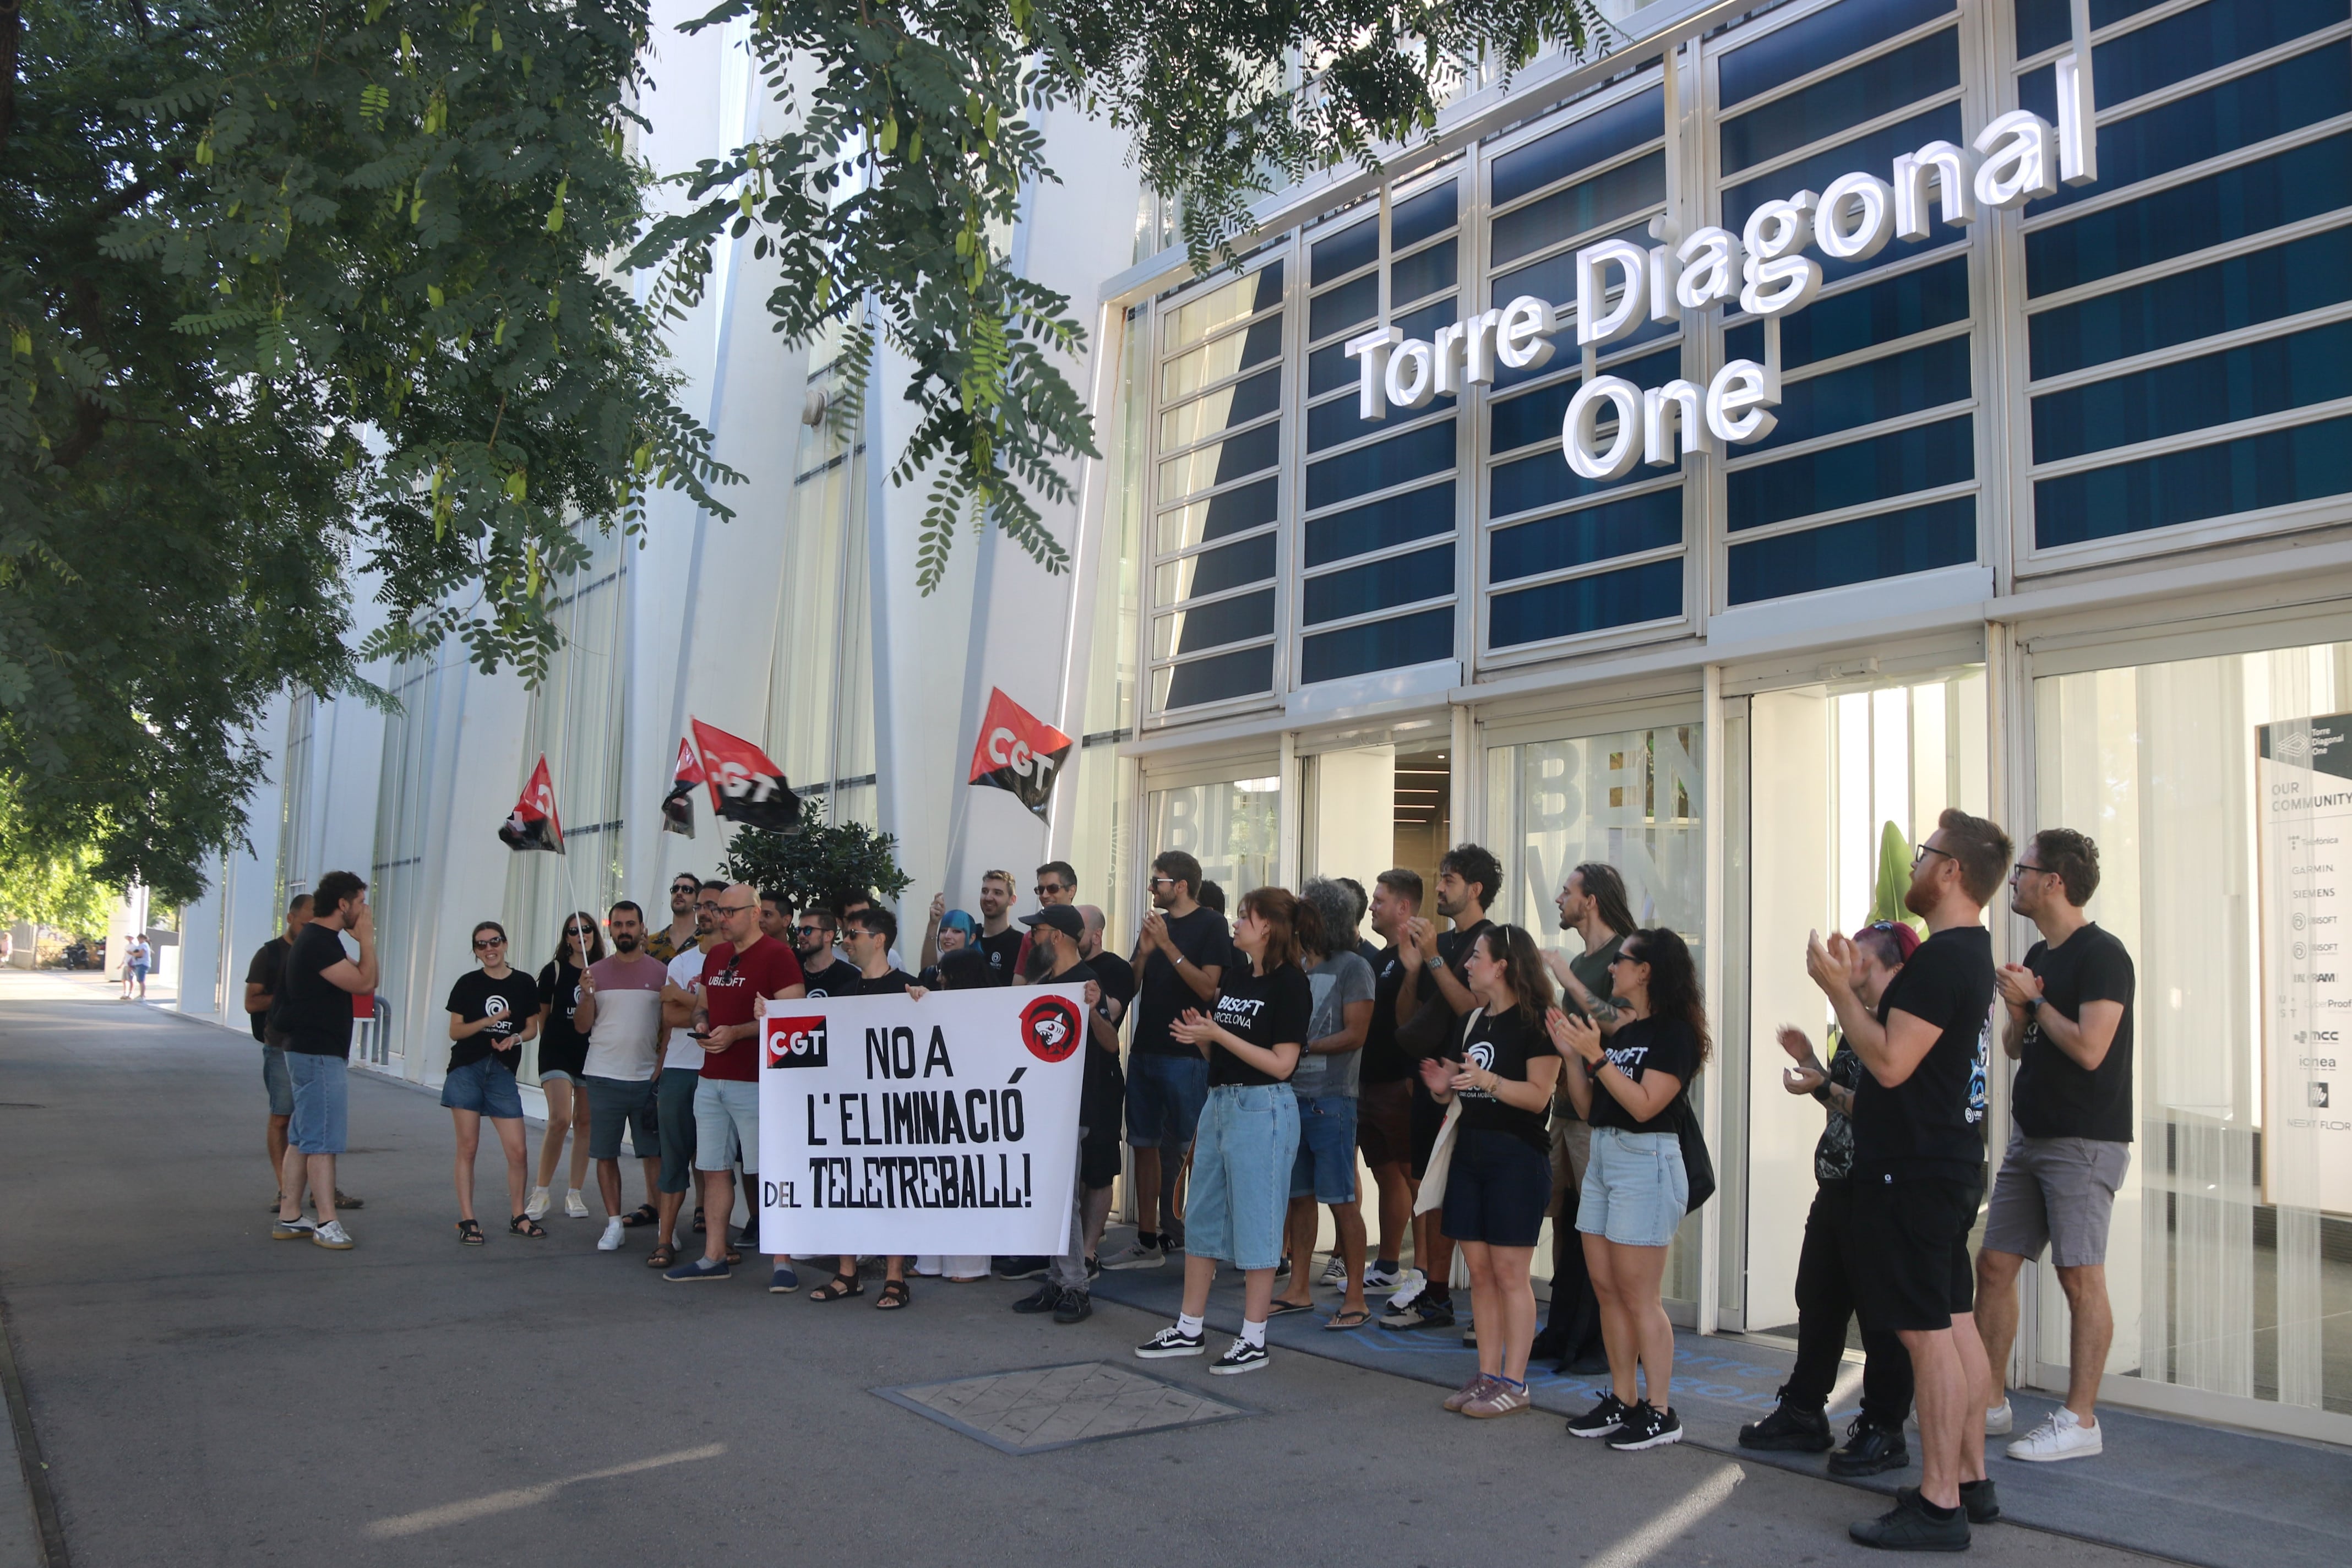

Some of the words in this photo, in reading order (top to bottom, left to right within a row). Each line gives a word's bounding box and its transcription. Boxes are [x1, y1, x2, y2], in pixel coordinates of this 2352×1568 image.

[1344, 294, 1556, 422] Torre
[1576, 53, 2097, 348] Diagonal
[1562, 358, 1780, 482] One
[2312, 727, 2331, 736] Torre
[2312, 733, 2345, 747] Diagonal
[988, 726, 1055, 791] CGT
[2312, 747, 2328, 756] One
[2272, 781, 2300, 796] OUR
[2272, 792, 2352, 812] COMMUNITY
[2301, 836, 2339, 846] fónica
[2291, 864, 2334, 875] GARMIN
[2293, 888, 2335, 899] SIEMENS
[1217, 995, 1265, 1016] BISOFT
[1213, 1011, 1251, 1030] ARCELONA
[769, 1030, 825, 1056] CGT
[866, 1026, 915, 1079] NO
[923, 1025, 954, 1078] A
[807, 1066, 1028, 1146] L'ELIMINACIÓ
[764, 1181, 802, 1208] DEL
[809, 1153, 1032, 1208] TELETREBALL!
